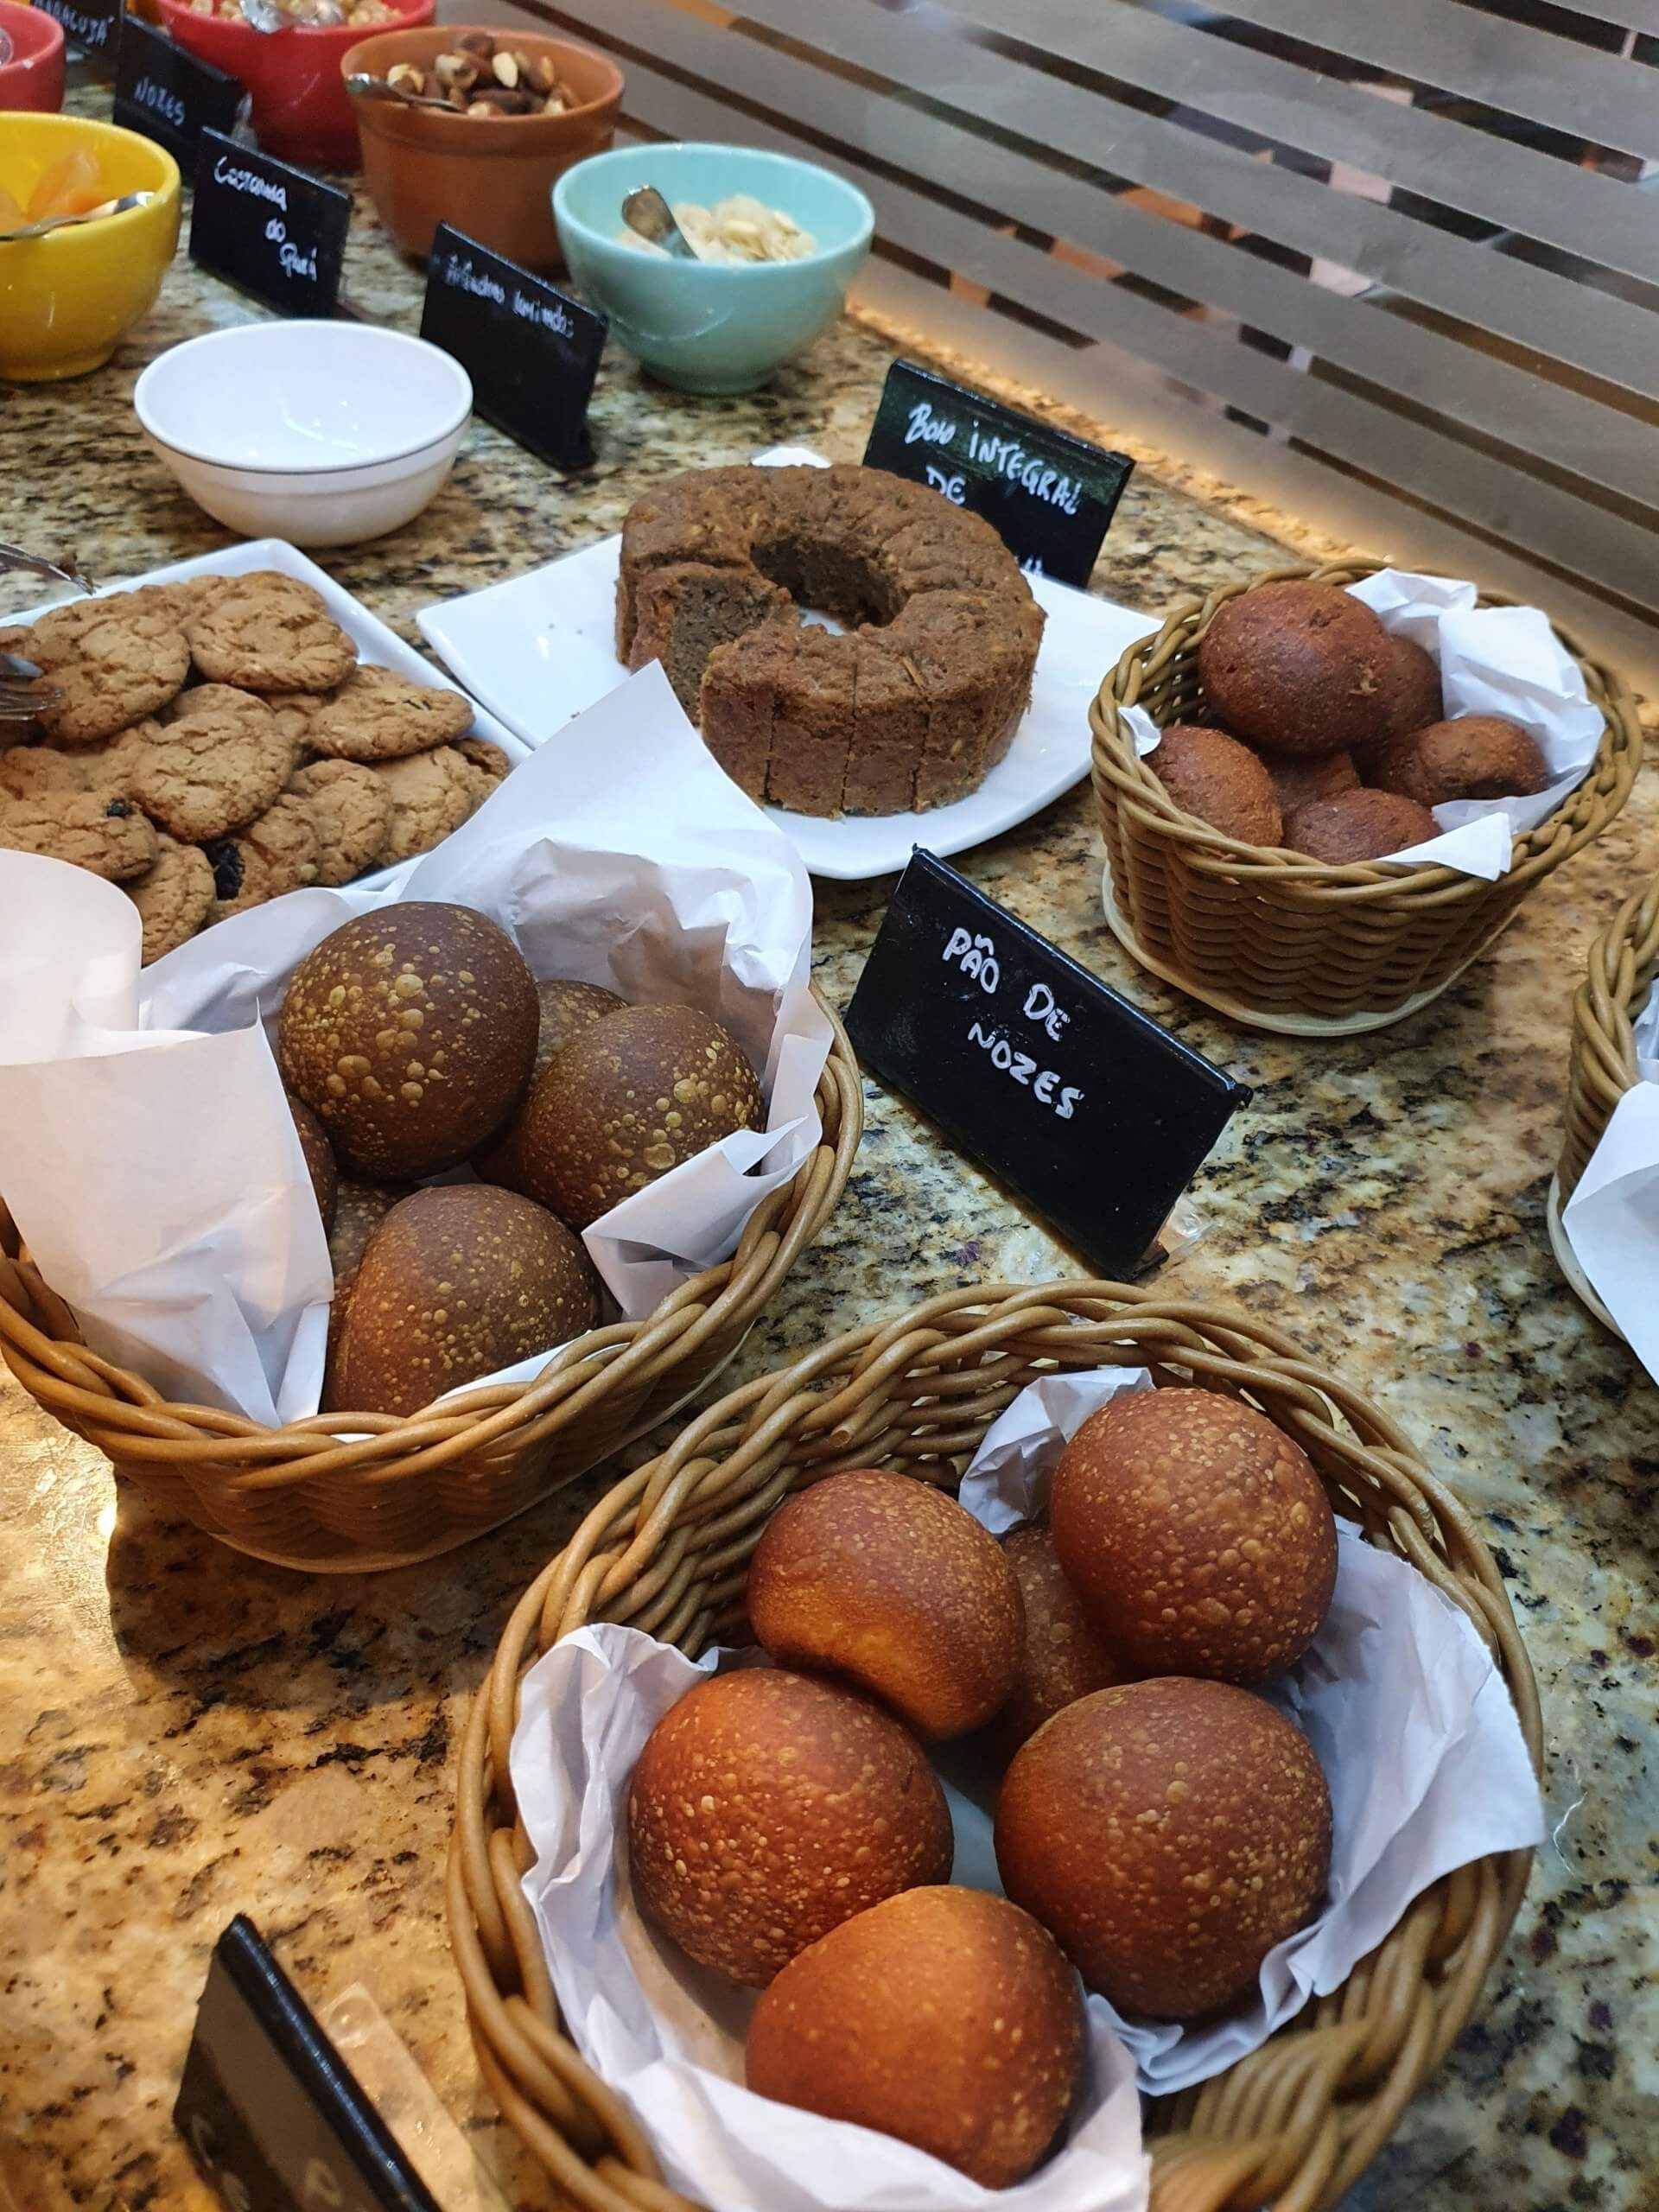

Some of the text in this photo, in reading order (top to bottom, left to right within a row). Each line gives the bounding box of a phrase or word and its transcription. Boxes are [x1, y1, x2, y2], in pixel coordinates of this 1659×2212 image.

[942, 926, 1071, 1042] PÃO DE
[967, 1022, 1085, 1120] NOZES
